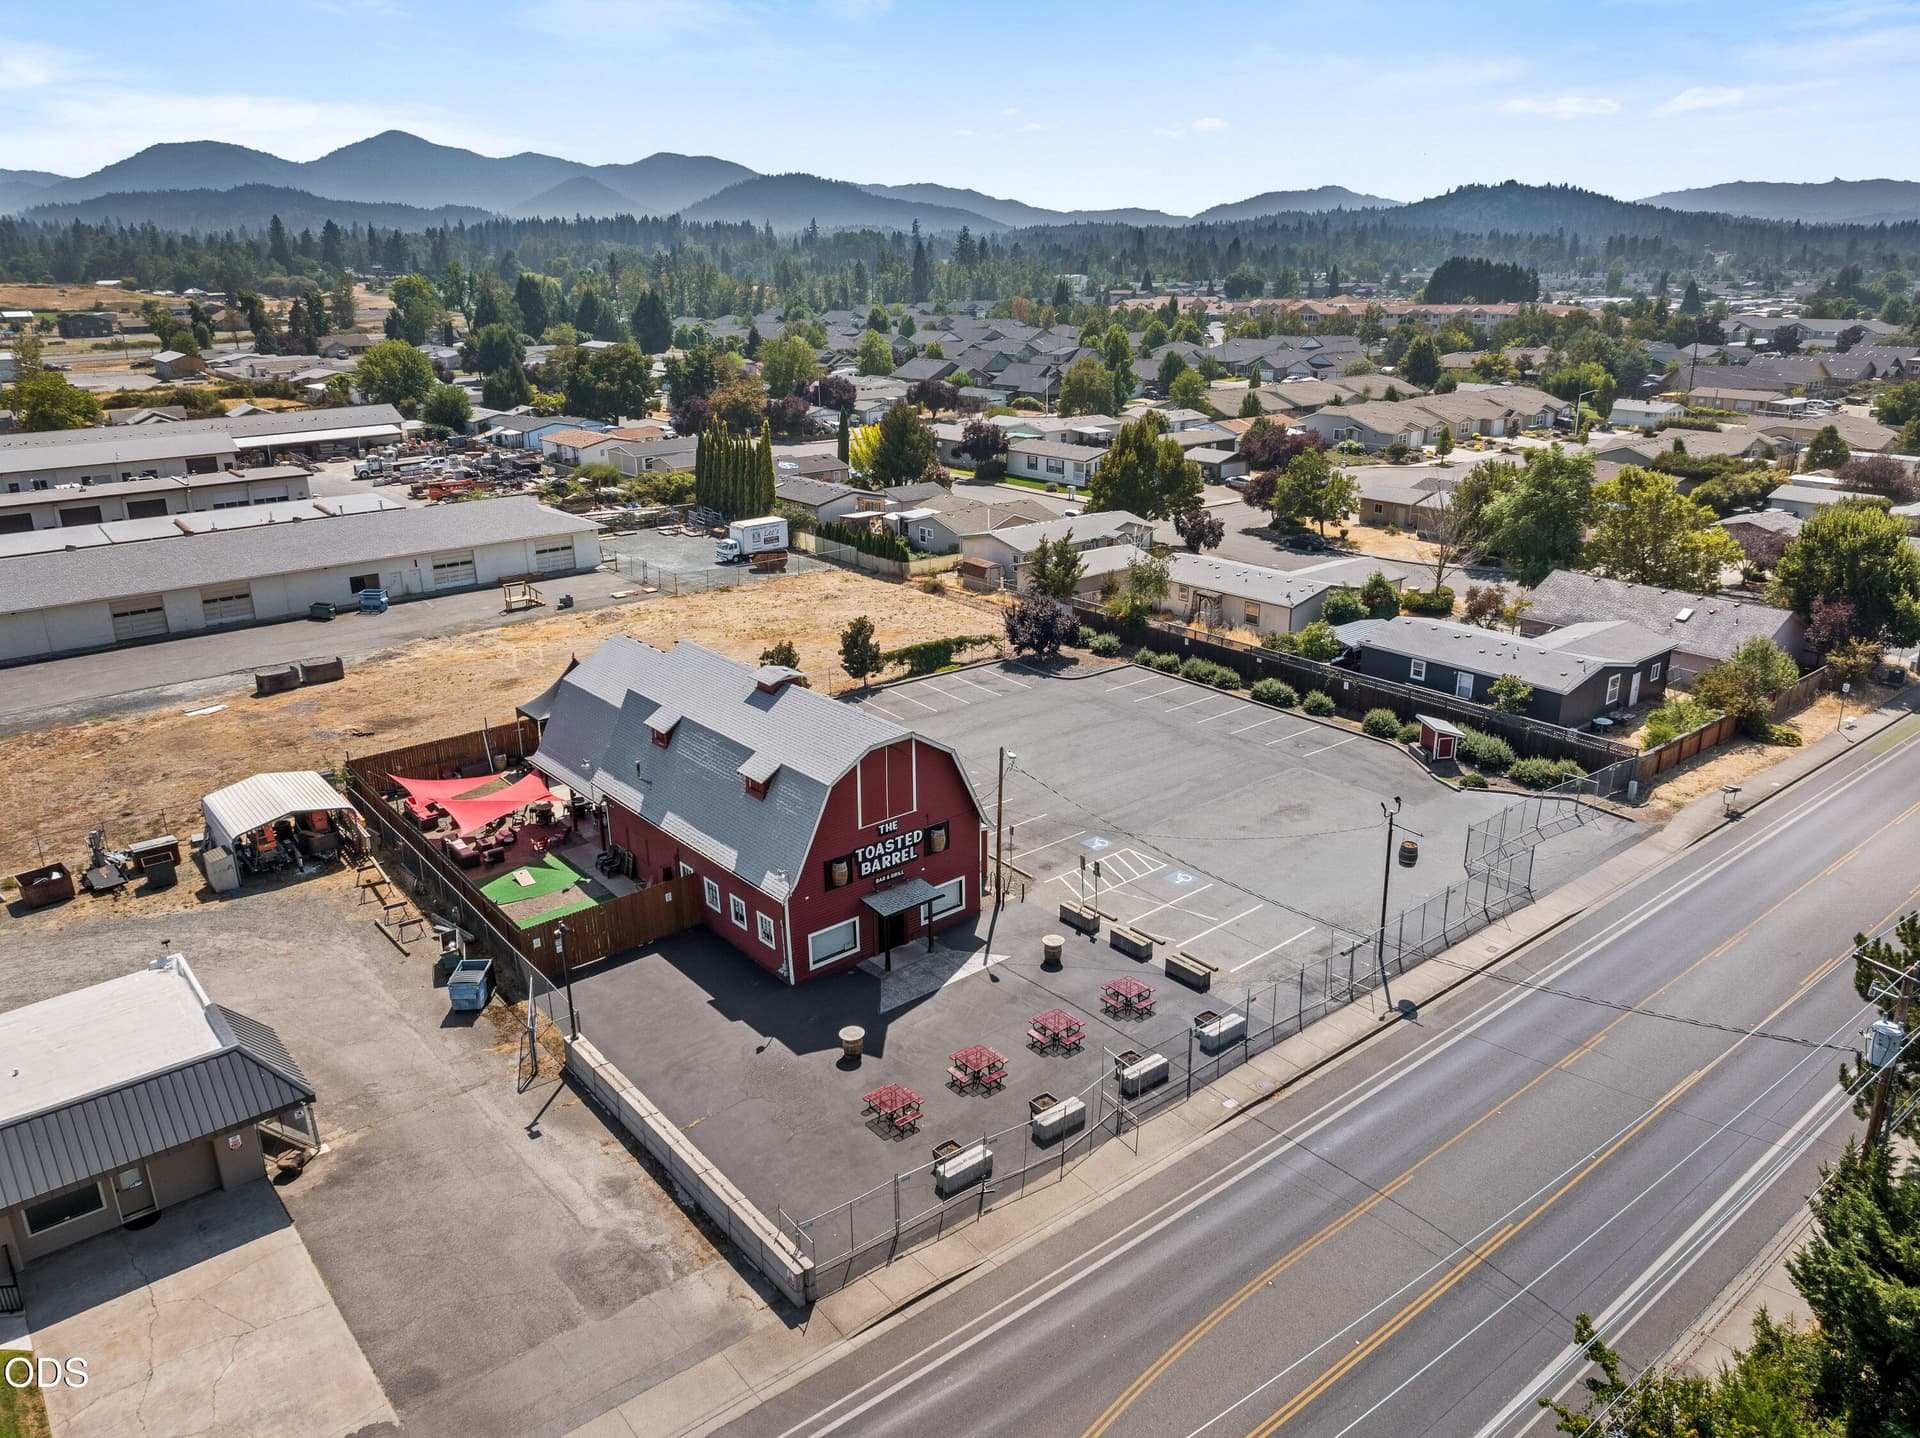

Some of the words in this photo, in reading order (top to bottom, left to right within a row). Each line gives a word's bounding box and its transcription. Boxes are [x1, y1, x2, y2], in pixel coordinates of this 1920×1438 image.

[878, 820, 898, 834] THE
[855, 830, 923, 862] TOASTED
[861, 846, 918, 876] BARREL
[875, 875, 886, 884] BAR
